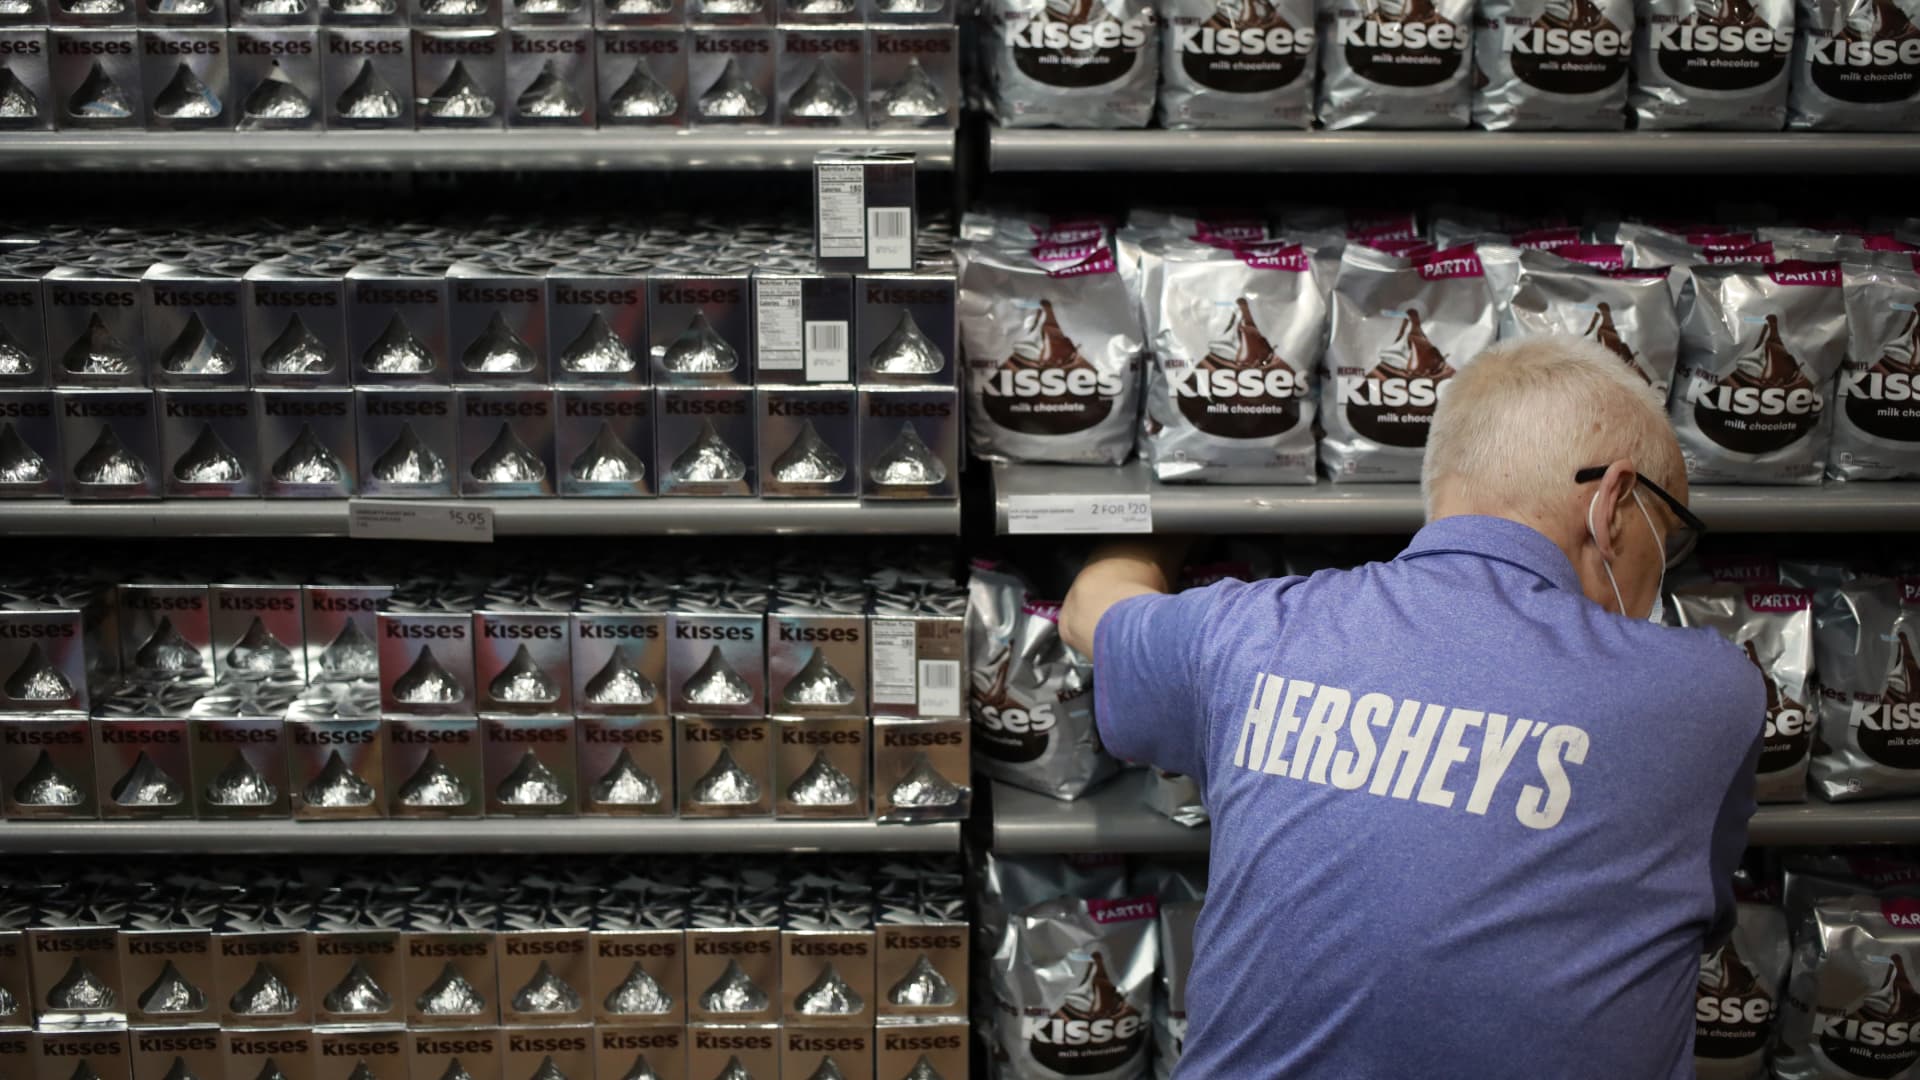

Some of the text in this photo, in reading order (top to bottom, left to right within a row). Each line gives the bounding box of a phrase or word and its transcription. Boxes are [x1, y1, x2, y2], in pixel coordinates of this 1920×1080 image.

[1807, 36, 1920, 66] Kisse
[1091, 504, 1099, 514] 2
[1102, 503, 1124, 514] FOR
[1850, 701, 1920, 730] Kiss
[1234, 672, 1590, 829] HERSHEY'S
[1020, 1015, 1140, 1044] Kisse
